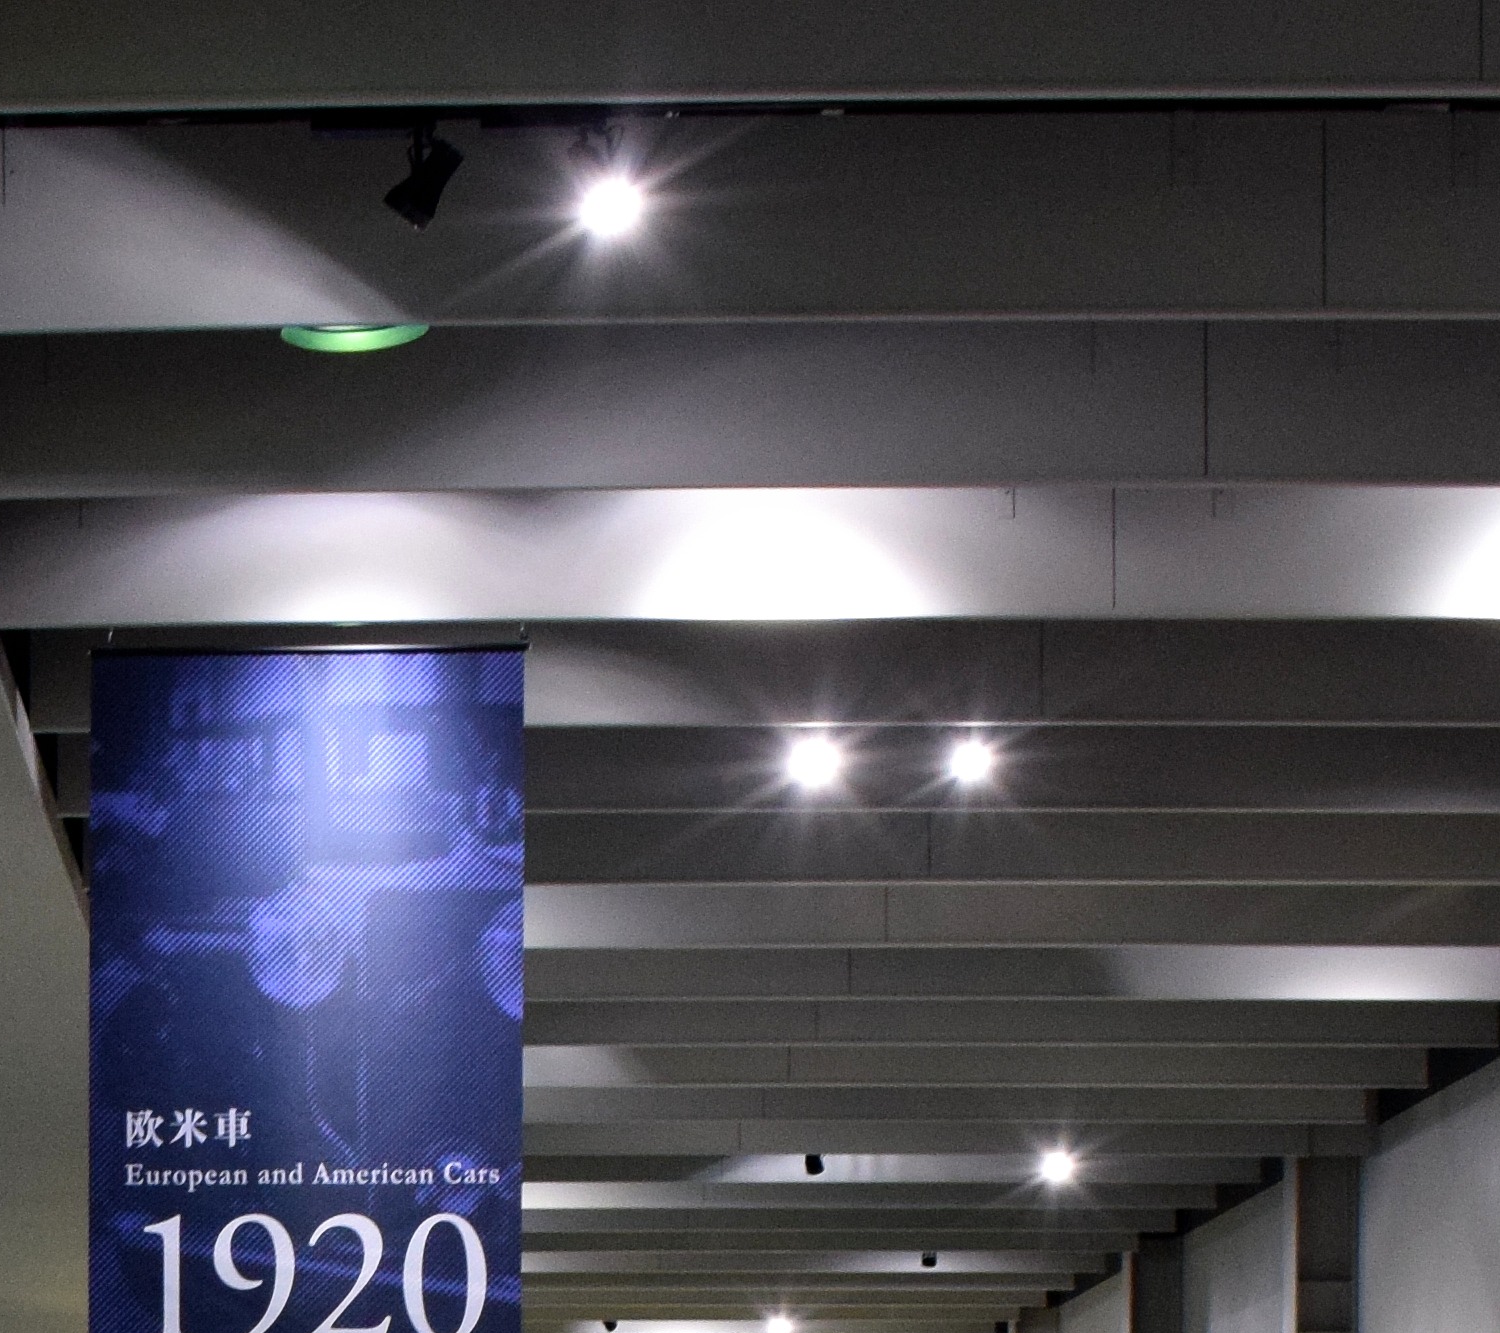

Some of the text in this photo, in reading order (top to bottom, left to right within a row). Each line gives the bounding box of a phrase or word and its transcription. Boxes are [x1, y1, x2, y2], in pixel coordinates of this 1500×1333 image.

[125, 1108, 252, 1149] 欧米車
[125, 1163, 501, 1192] European and American Cars
